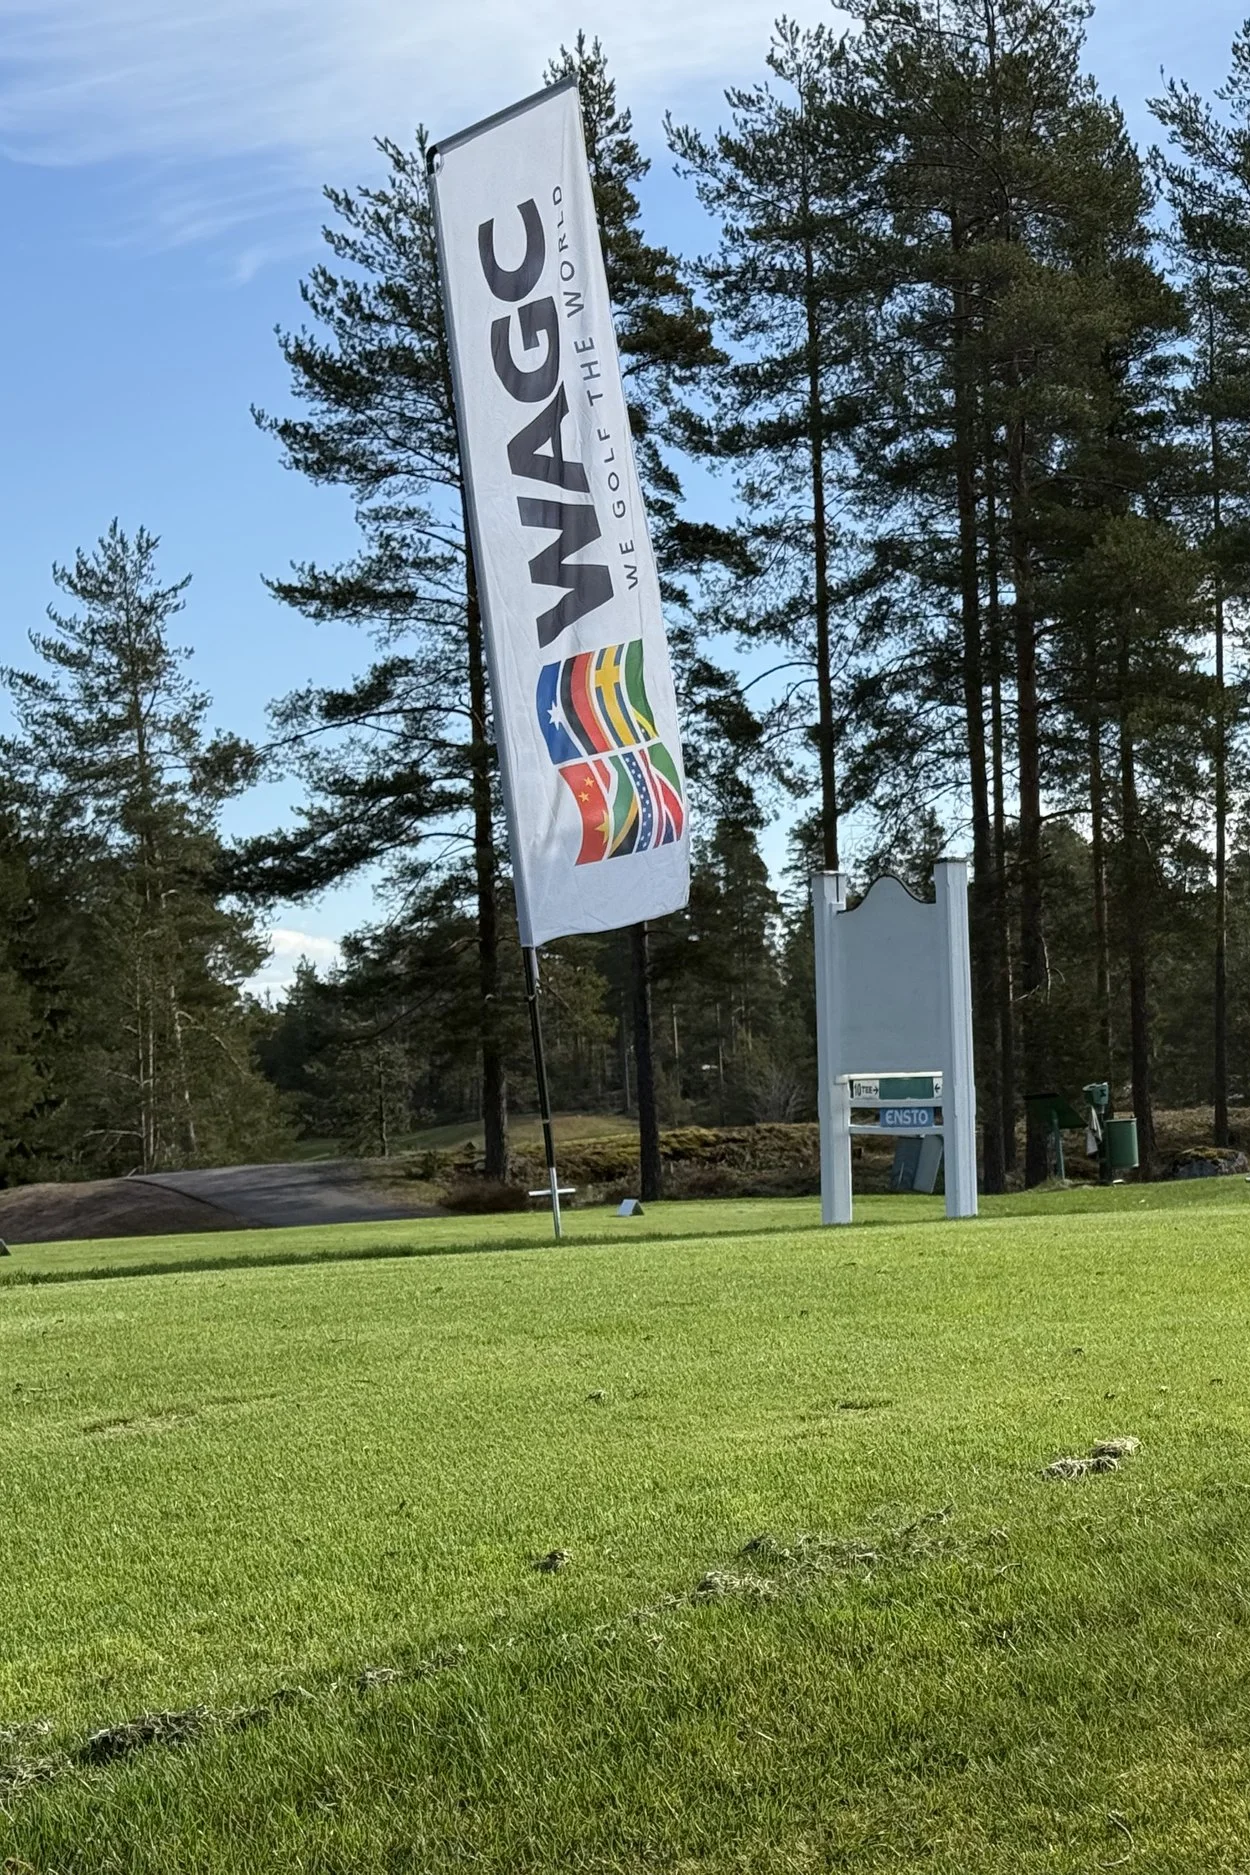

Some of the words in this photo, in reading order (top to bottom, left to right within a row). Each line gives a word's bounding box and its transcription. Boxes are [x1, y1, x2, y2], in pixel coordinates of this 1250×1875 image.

[552, 185, 584, 318] WORLD
[574, 336, 603, 407] THE
[478, 198, 614, 648] WAGC
[597, 428, 626, 518] GOLF
[619, 539, 639, 590] WE
[861, 1085, 873, 1094] TEE
[885, 1109, 929, 1125] ENSTO
